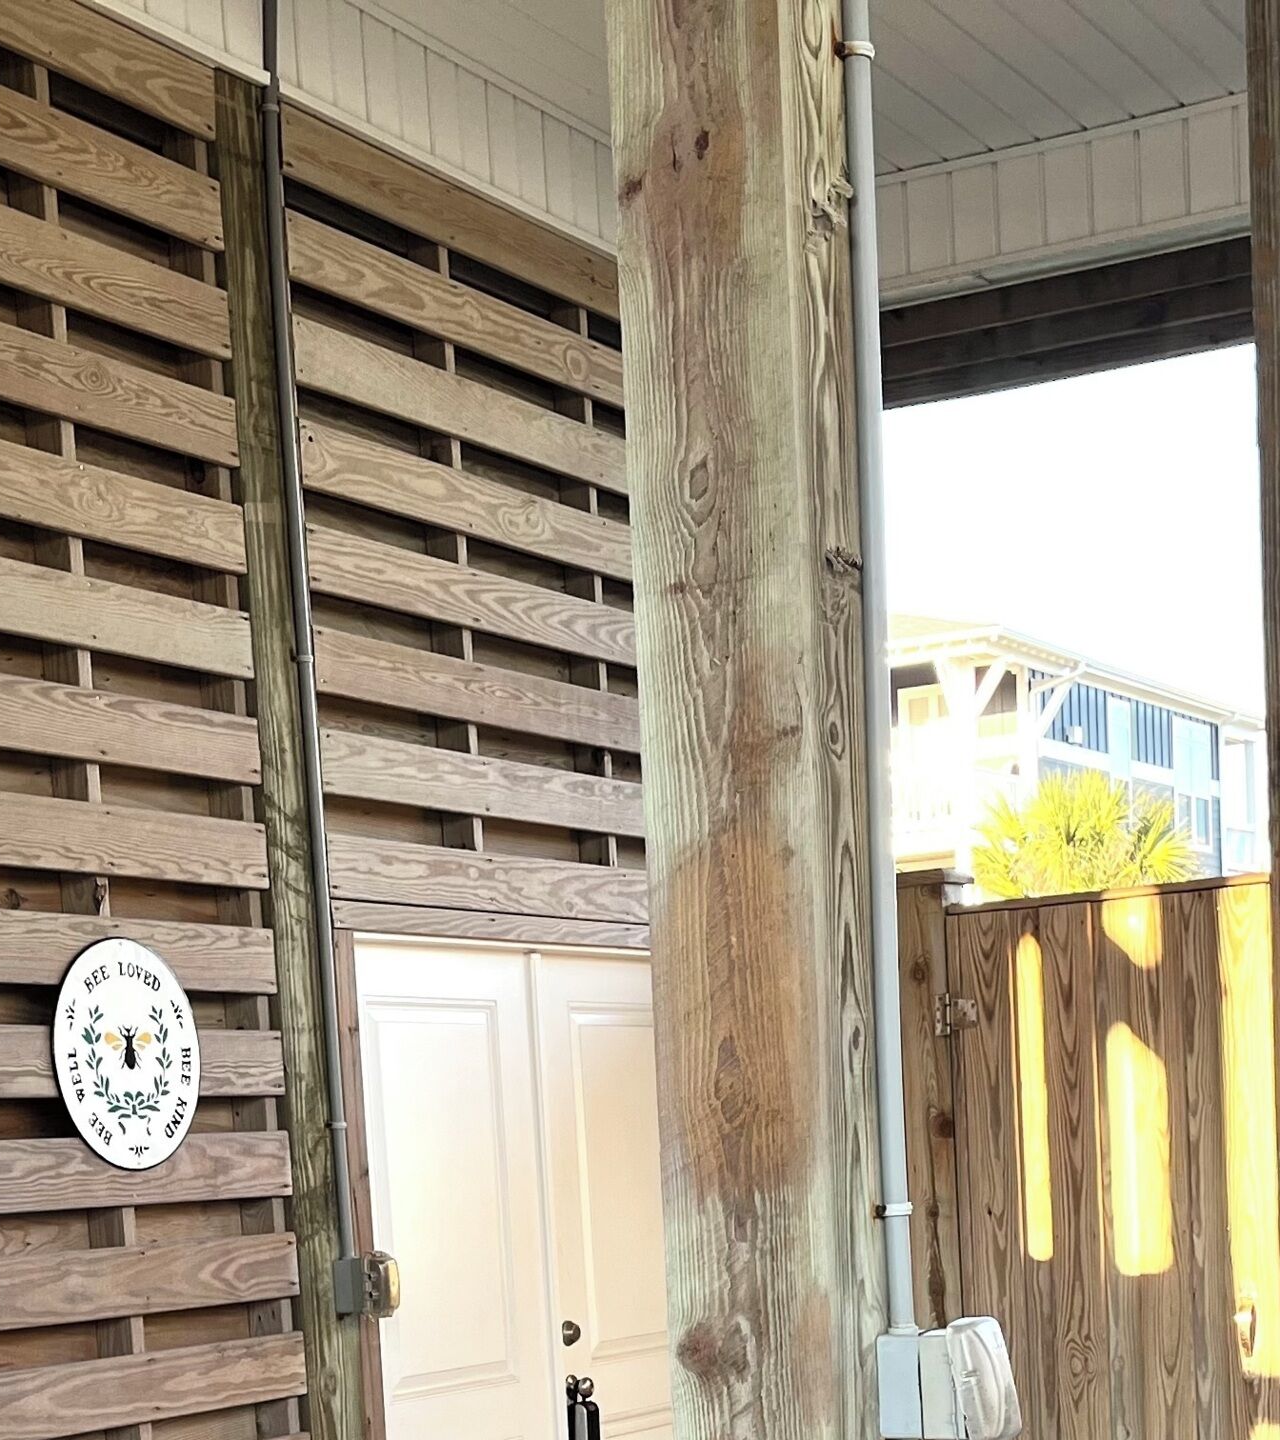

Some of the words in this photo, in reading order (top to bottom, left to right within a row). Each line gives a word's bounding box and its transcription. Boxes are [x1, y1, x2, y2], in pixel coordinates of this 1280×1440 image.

[83, 964, 111, 994] BEE
[117, 961, 162, 993] LOVED
[67, 1046, 86, 1104] WELL
[180, 1046, 192, 1087] BEE
[88, 1111, 113, 1147] BEE
[164, 1096, 188, 1140] KIND
